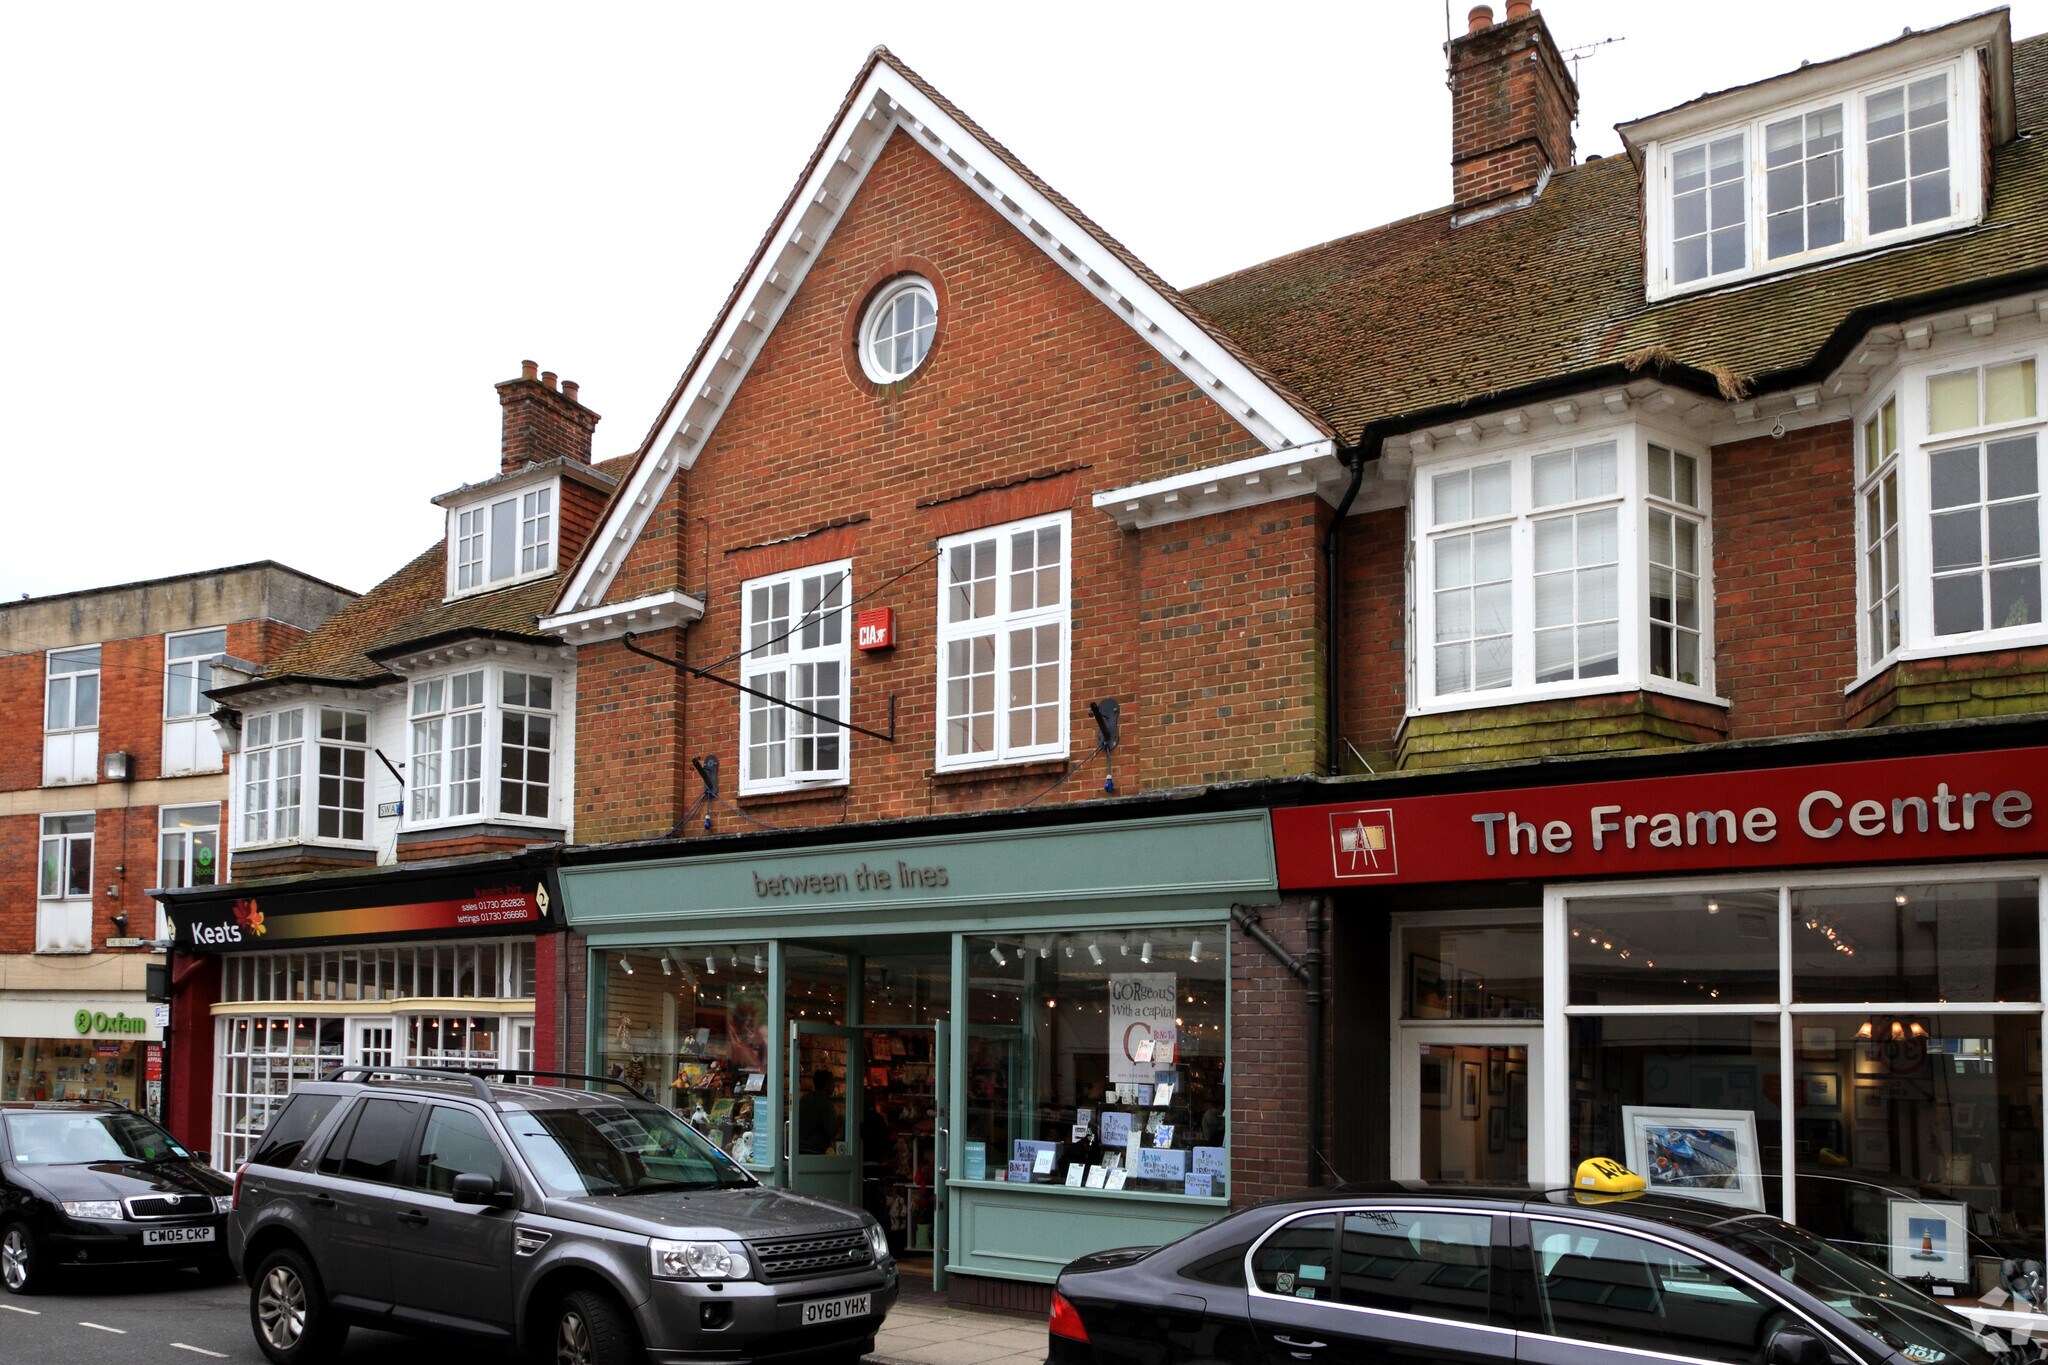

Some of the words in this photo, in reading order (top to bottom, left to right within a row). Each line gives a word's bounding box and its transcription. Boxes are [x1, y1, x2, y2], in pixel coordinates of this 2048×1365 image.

[859, 625, 877, 646] CIA
[381, 803, 400, 816] SWA
[1472, 811, 1573, 856] The
[1590, 804, 1778, 851] Frame
[1798, 782, 2033, 839] Centre
[752, 870, 848, 897] between
[854, 862, 891, 891] the
[896, 860, 948, 888] lines
[462, 903, 478, 912] sales
[478, 900, 499, 910] 01730
[501, 898, 526, 908] 262826
[539, 893, 546, 907] 2
[457, 914, 480, 923] lettings
[481, 911, 501, 921] 01730
[192, 921, 242, 944] Keats
[1135, 1007, 1141, 1016] a
[1142, 1004, 1175, 1020] capital
[92, 1011, 146, 1034] Oxfam
[149, 1229, 183, 1242] CW05
[186, 1228, 210, 1240] CKP
[746, 1228, 791, 1237] LAND
[816, 1221, 860, 1232] ROVER
[808, 1301, 841, 1321] OY60
[845, 1297, 867, 1314] YHX
